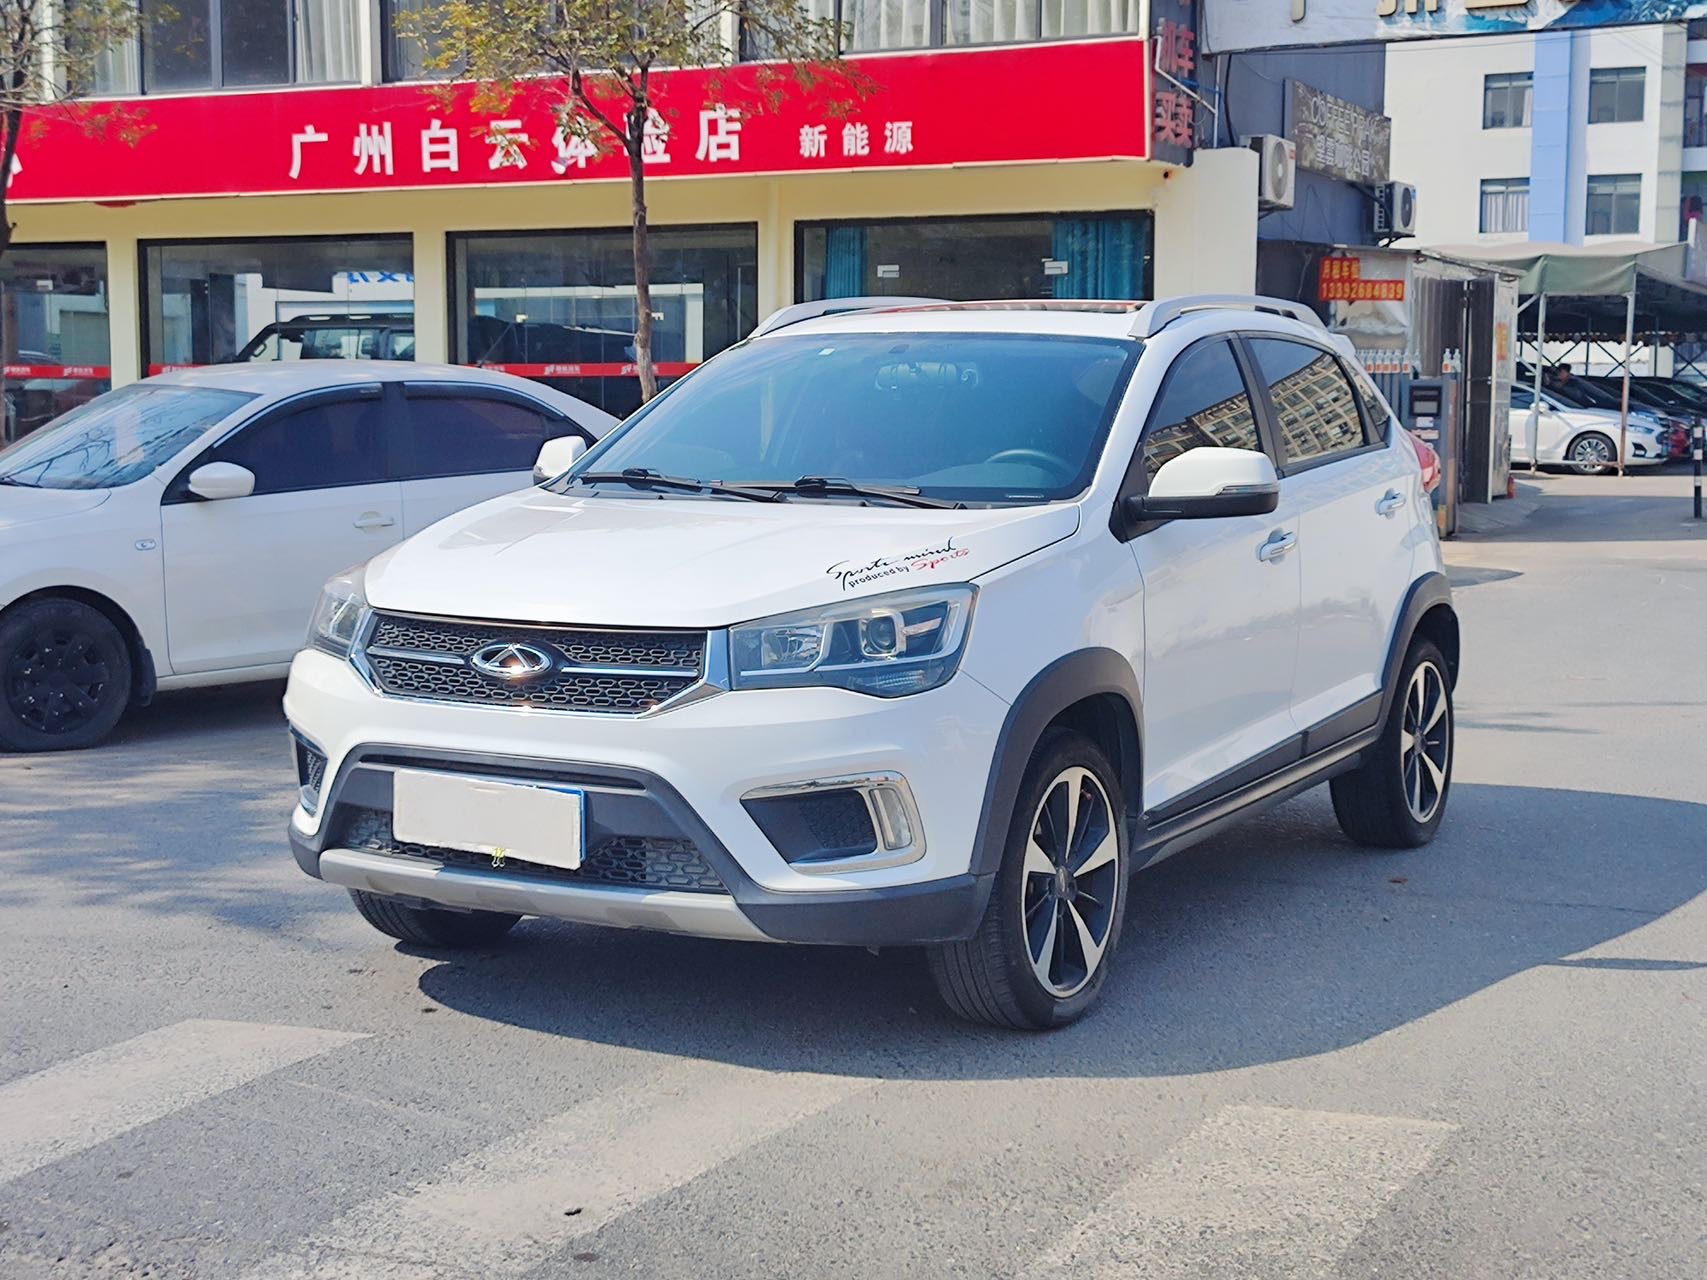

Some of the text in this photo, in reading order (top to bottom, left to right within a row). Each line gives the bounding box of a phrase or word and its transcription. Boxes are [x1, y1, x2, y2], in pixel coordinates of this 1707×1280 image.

[799, 121, 914, 158] 新能源
[848, 566, 896, 588] produced
[898, 562, 910, 573] by
